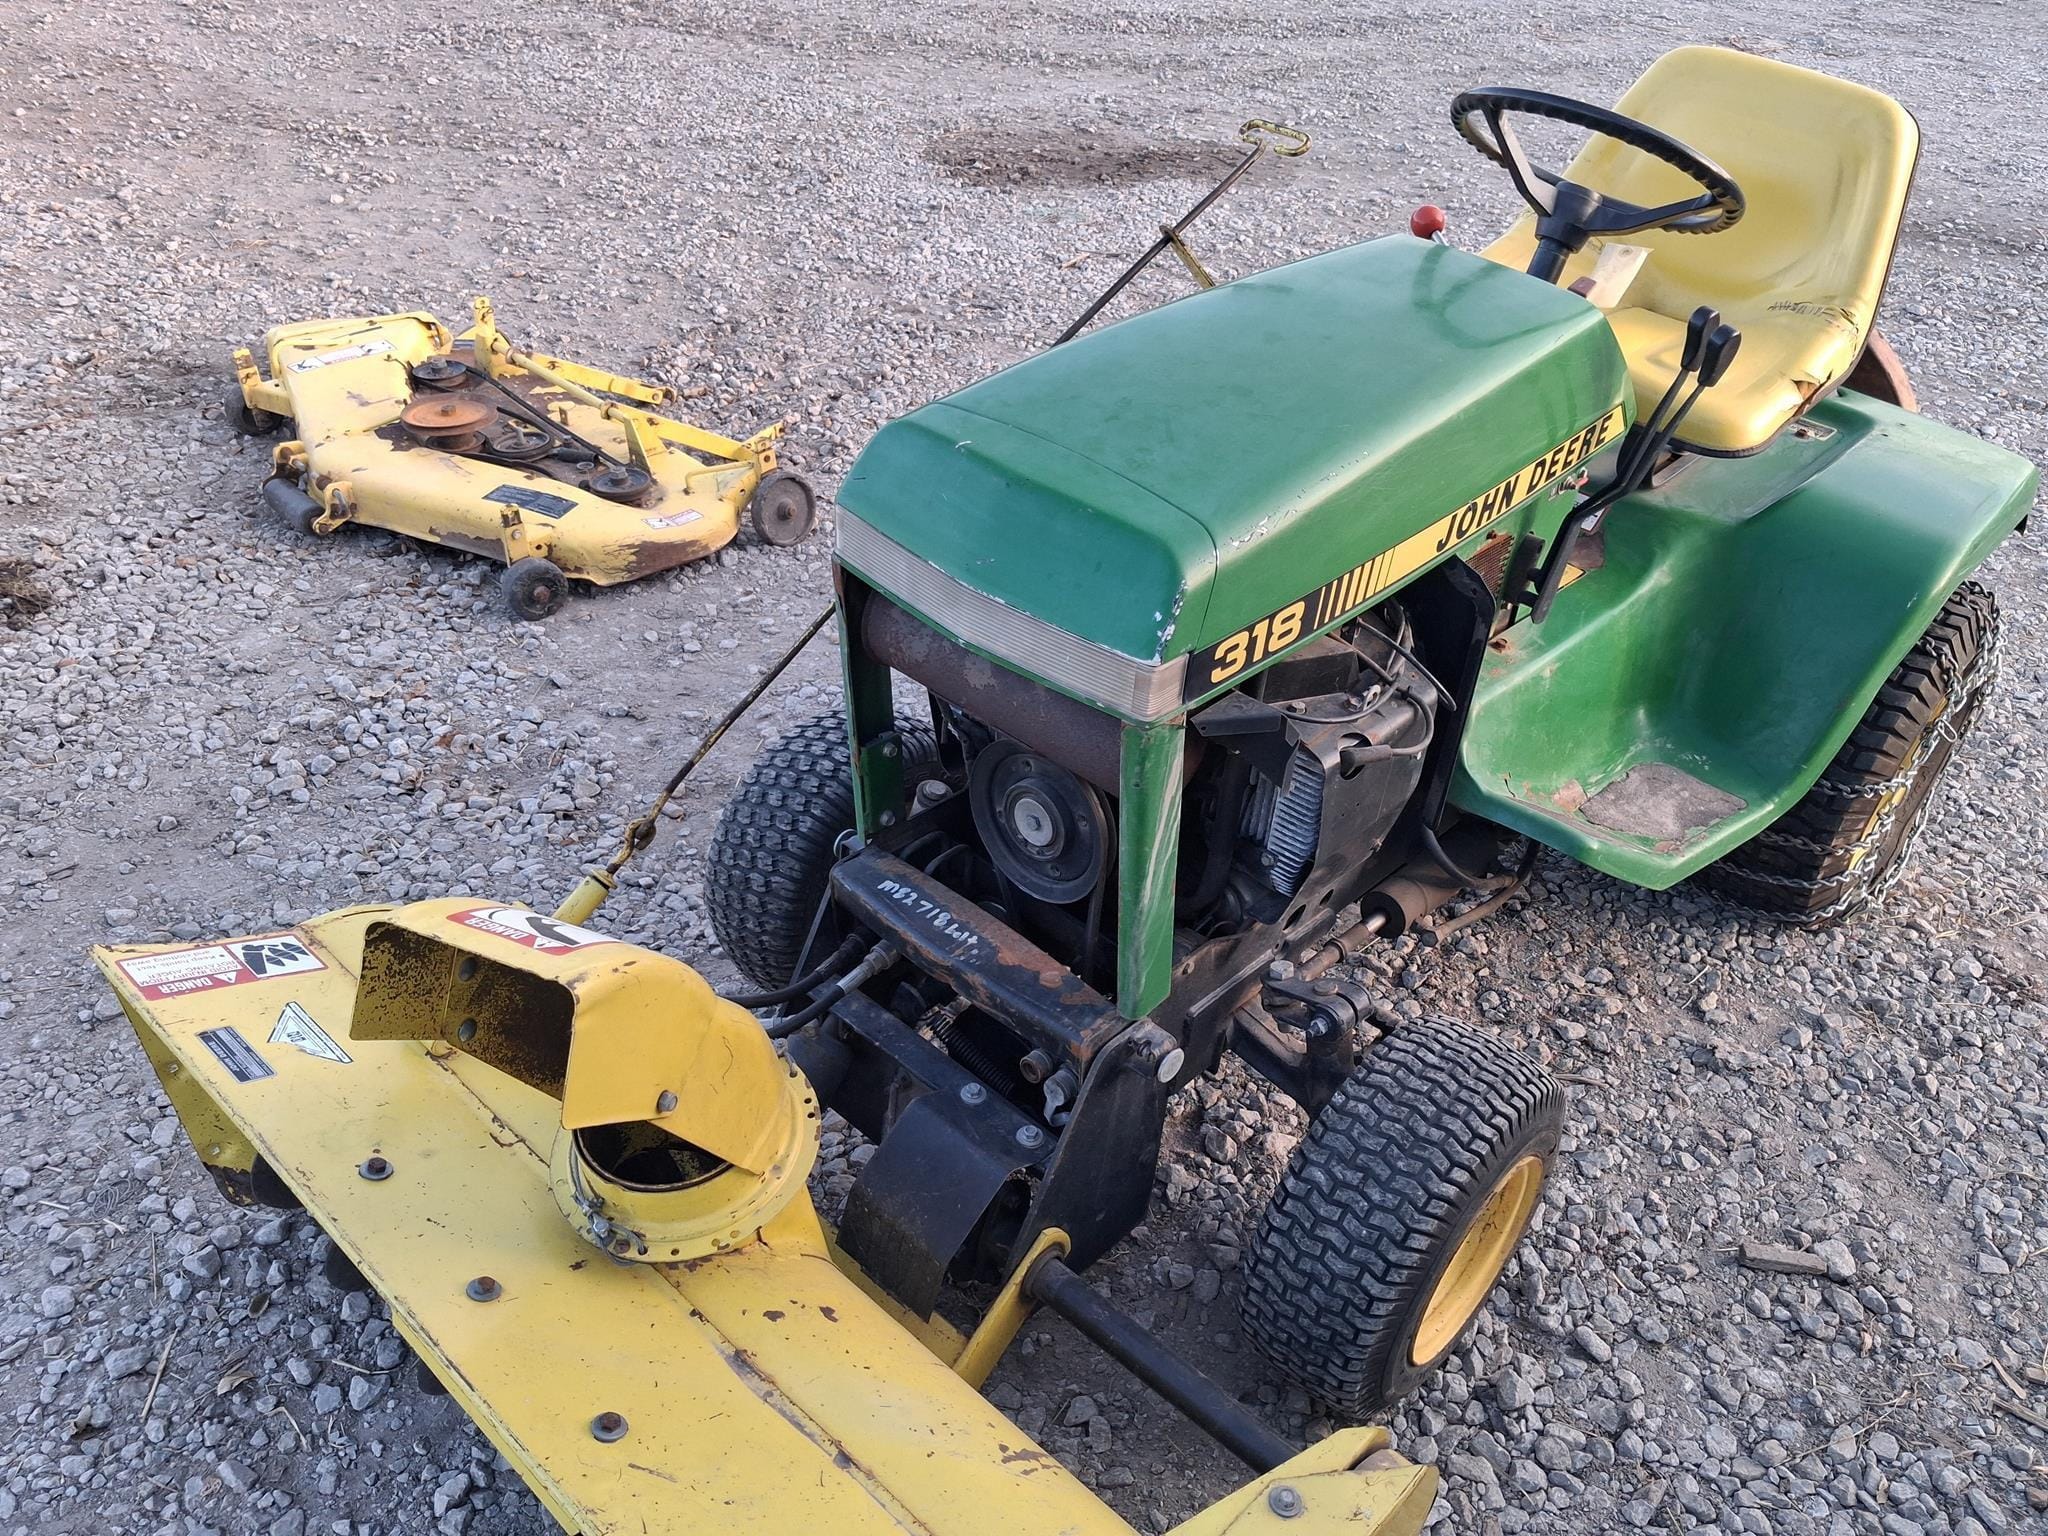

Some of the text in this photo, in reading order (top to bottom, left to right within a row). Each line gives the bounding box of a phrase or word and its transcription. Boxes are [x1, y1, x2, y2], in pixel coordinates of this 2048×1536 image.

[1436, 483, 1519, 552] JOHN
[1526, 413, 1614, 494] DEERE
[1211, 601, 1305, 684] 318
[464, 917, 529, 939] DANGER
[140, 964, 239, 985] AVOID INJURY FROM
[148, 960, 235, 978] ROTATING AUGER
[159, 977, 213, 994] DANGER
